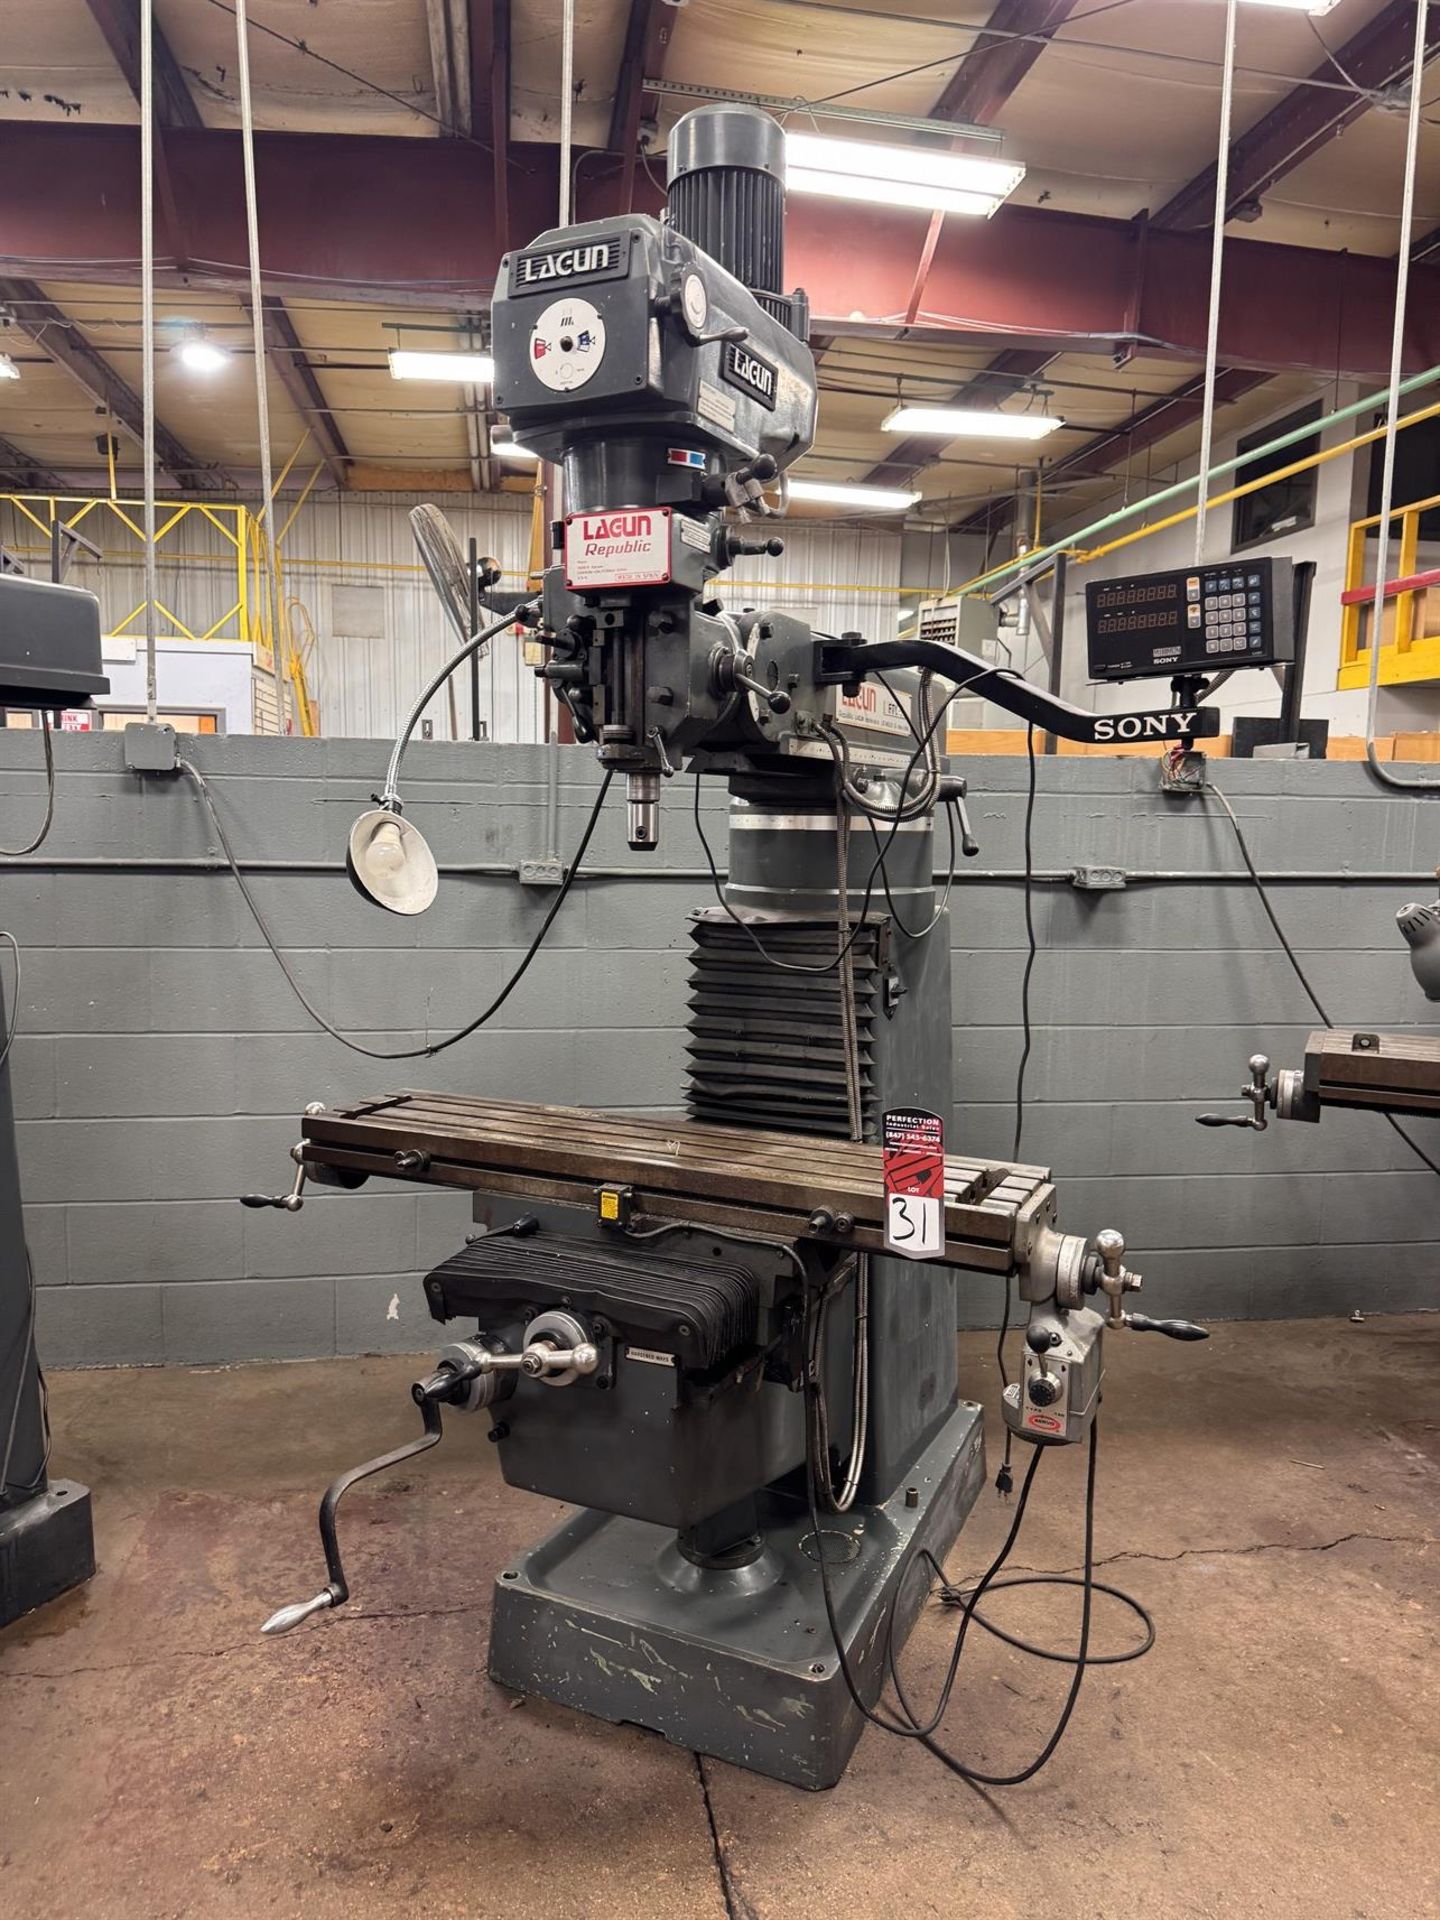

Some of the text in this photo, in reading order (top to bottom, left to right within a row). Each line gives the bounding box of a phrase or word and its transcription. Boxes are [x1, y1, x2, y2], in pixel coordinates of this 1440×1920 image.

[525, 244, 609, 282] LAGUN
[732, 347, 774, 397] LAGUN
[583, 515, 652, 541] LAGUN
[585, 540, 652, 558] Republic
[1153, 656, 1179, 665] SONY
[1093, 712, 1197, 741] SONY
[886, 1114, 940, 1126] PERFECTION
[907, 1186, 921, 1194] LOT
[892, 1196, 927, 1245] 31
